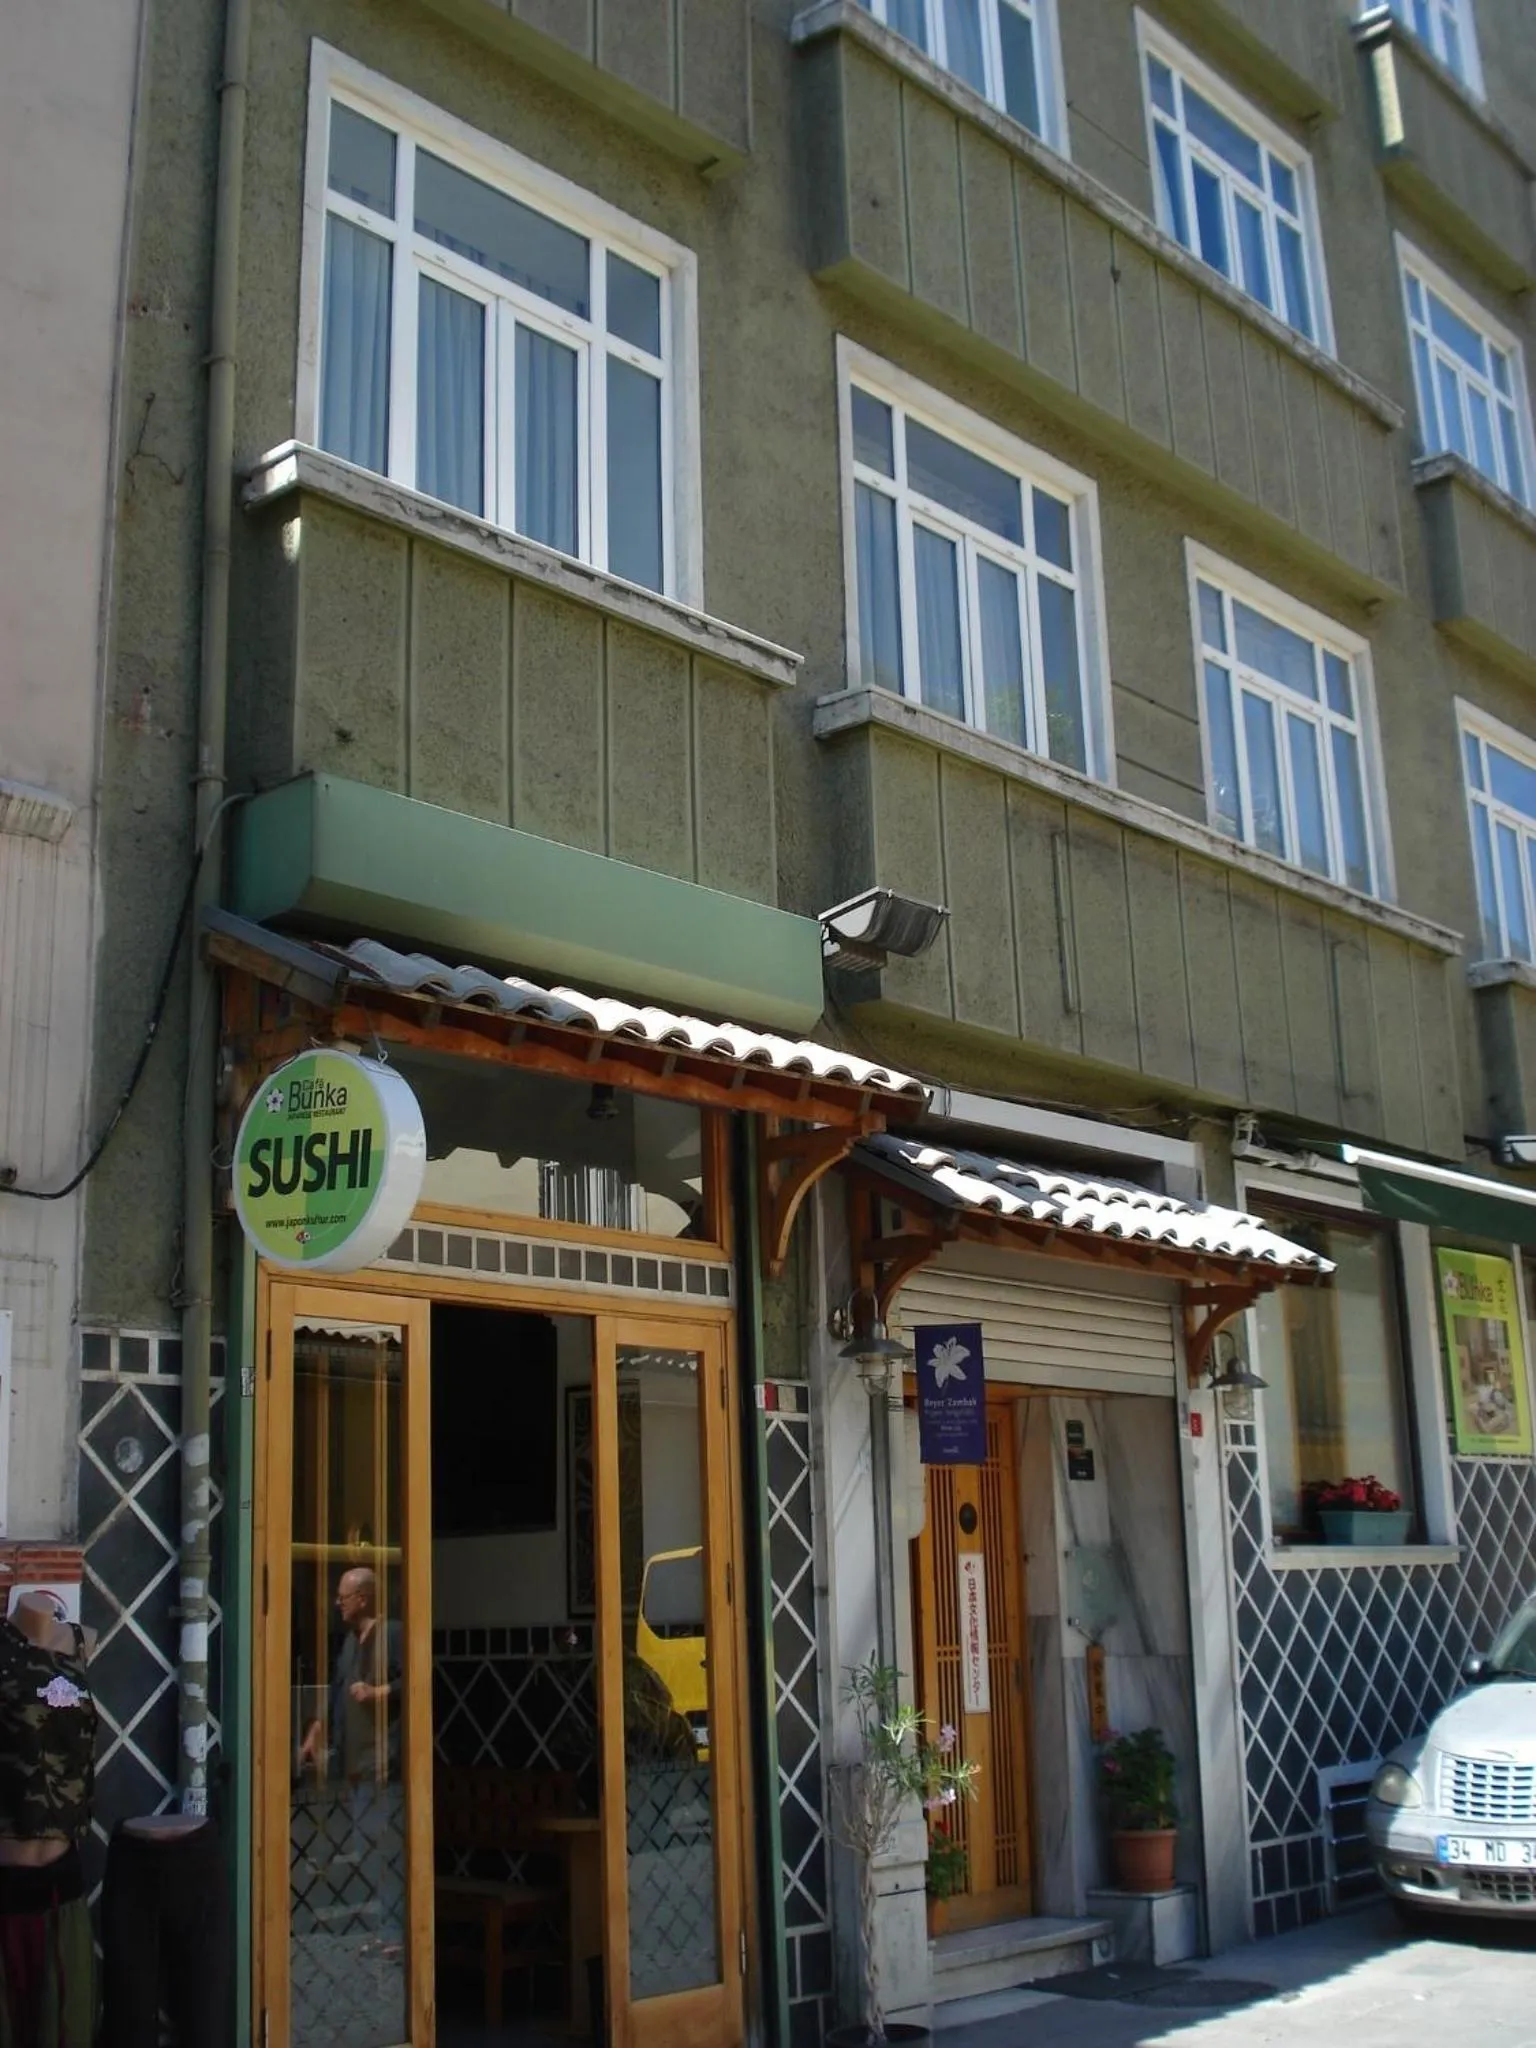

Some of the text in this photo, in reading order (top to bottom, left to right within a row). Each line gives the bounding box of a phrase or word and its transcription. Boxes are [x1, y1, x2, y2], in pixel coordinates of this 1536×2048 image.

[288, 1080, 348, 1112] Bunka
[247, 1128, 373, 1198] SUSHI
[1450, 1839, 1471, 1860] 34
